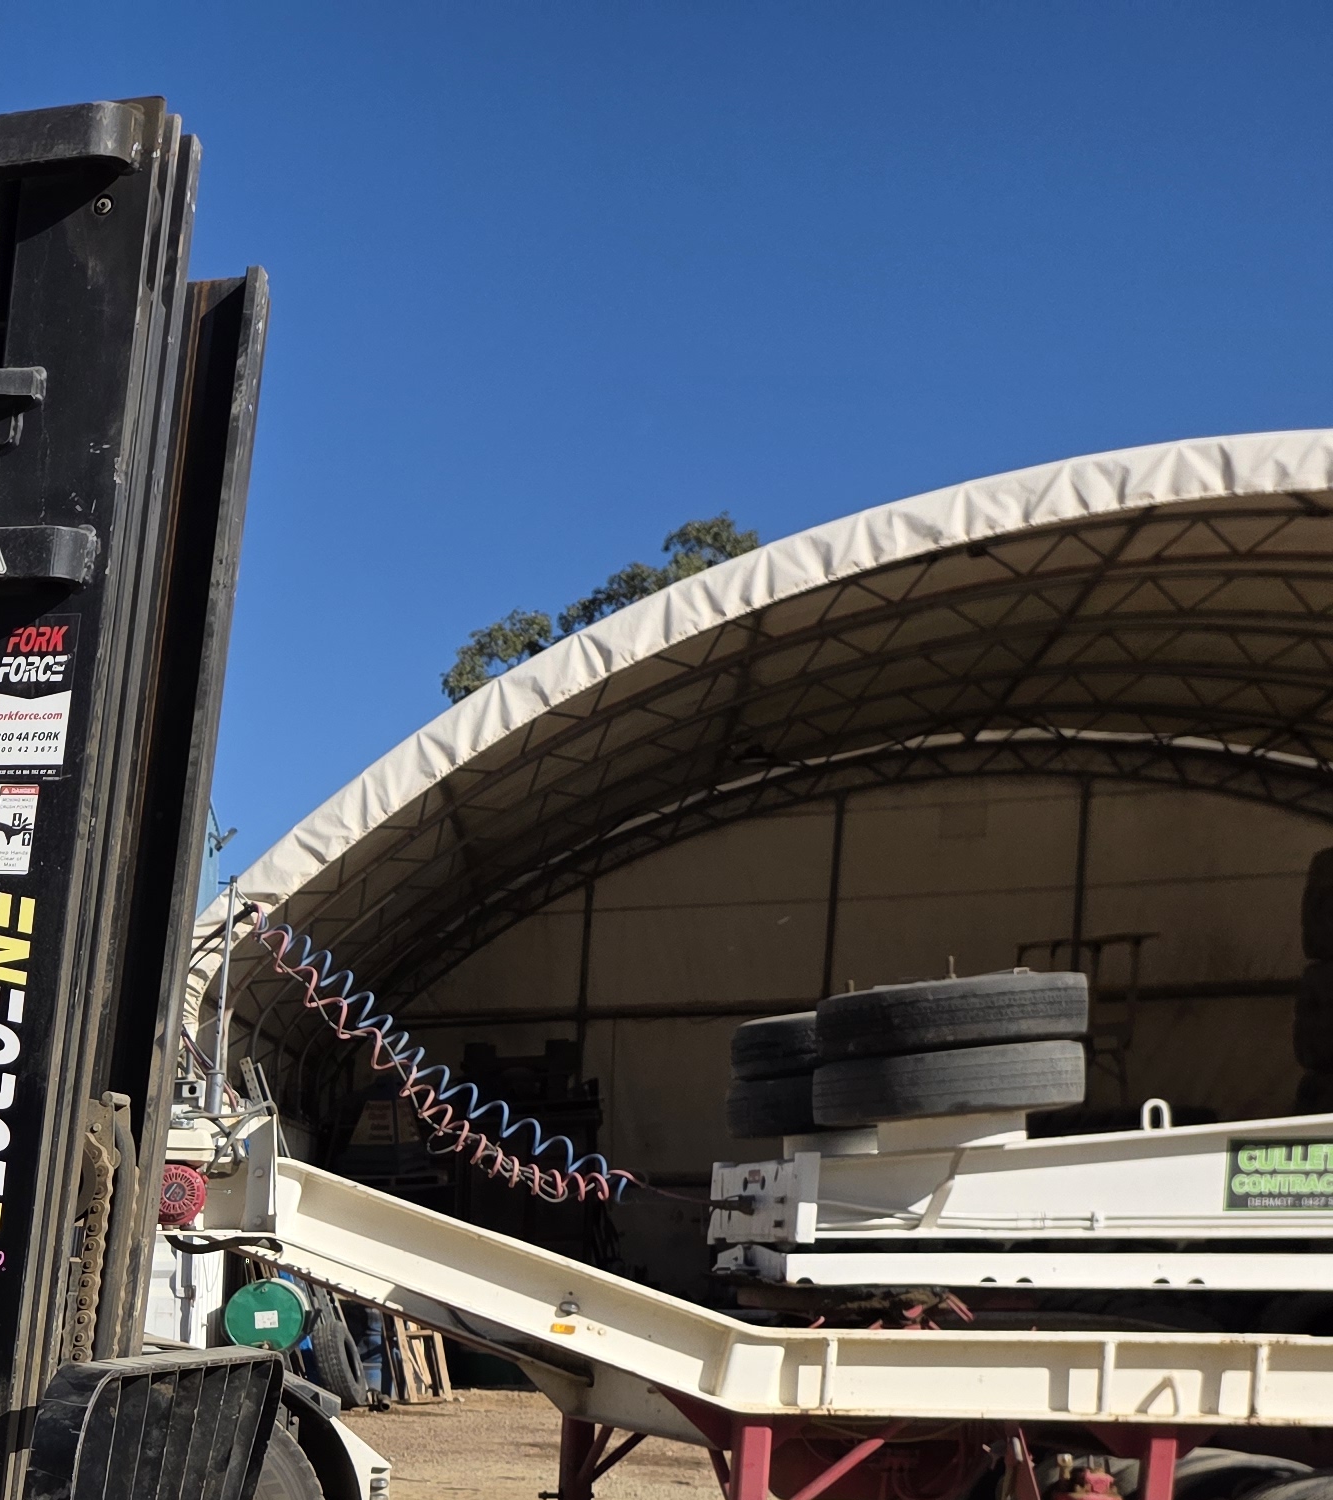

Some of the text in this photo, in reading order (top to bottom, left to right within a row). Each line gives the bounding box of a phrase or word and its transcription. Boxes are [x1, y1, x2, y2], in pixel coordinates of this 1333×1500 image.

[6, 626, 69, 653] FORK
[16, 732, 29, 742] 4A
[31, 731, 61, 742] FORK
[33, 745, 59, 753] 3675
